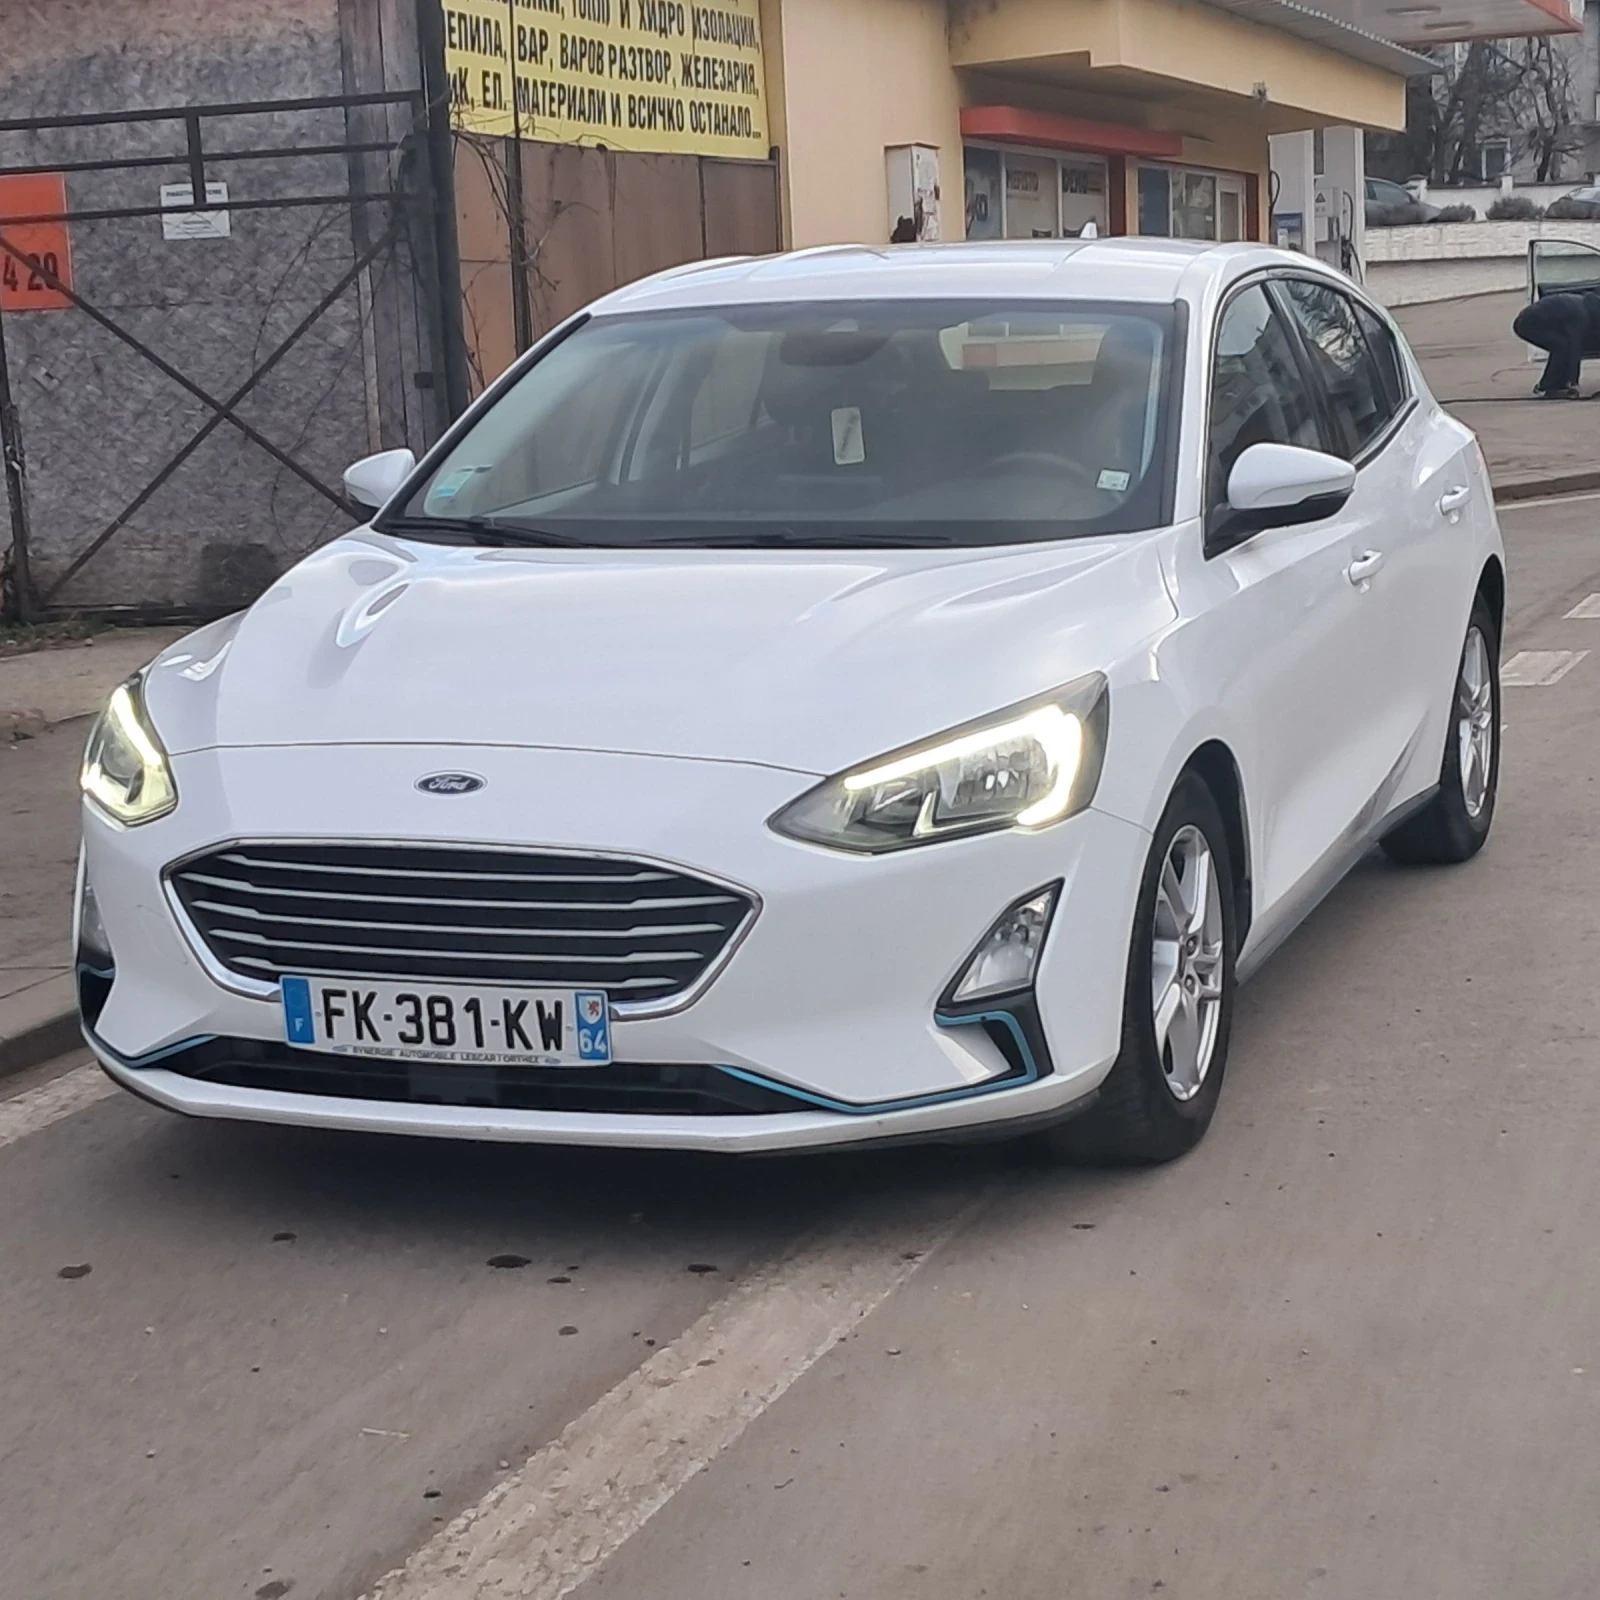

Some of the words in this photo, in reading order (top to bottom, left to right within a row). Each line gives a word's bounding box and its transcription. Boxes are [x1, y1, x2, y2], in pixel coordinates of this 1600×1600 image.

[638, 0, 685, 39] ХИДРО
[560, 32, 604, 76] ВАРОВ
[680, 52, 759, 98] ЖЕЛЕЗАРИЯ,
[481, 70, 507, 111] ЕЛ.
[516, 76, 607, 125] МАТЕРИАЛИ
[611, 92, 621, 128] И
[628, 93, 685, 133] ВСИЧКО
[428, 776, 470, 790] Ford
[295, 1017, 304, 1032] F
[321, 988, 562, 1051] FK-381-KW
[579, 1028, 607, 1054] 64
